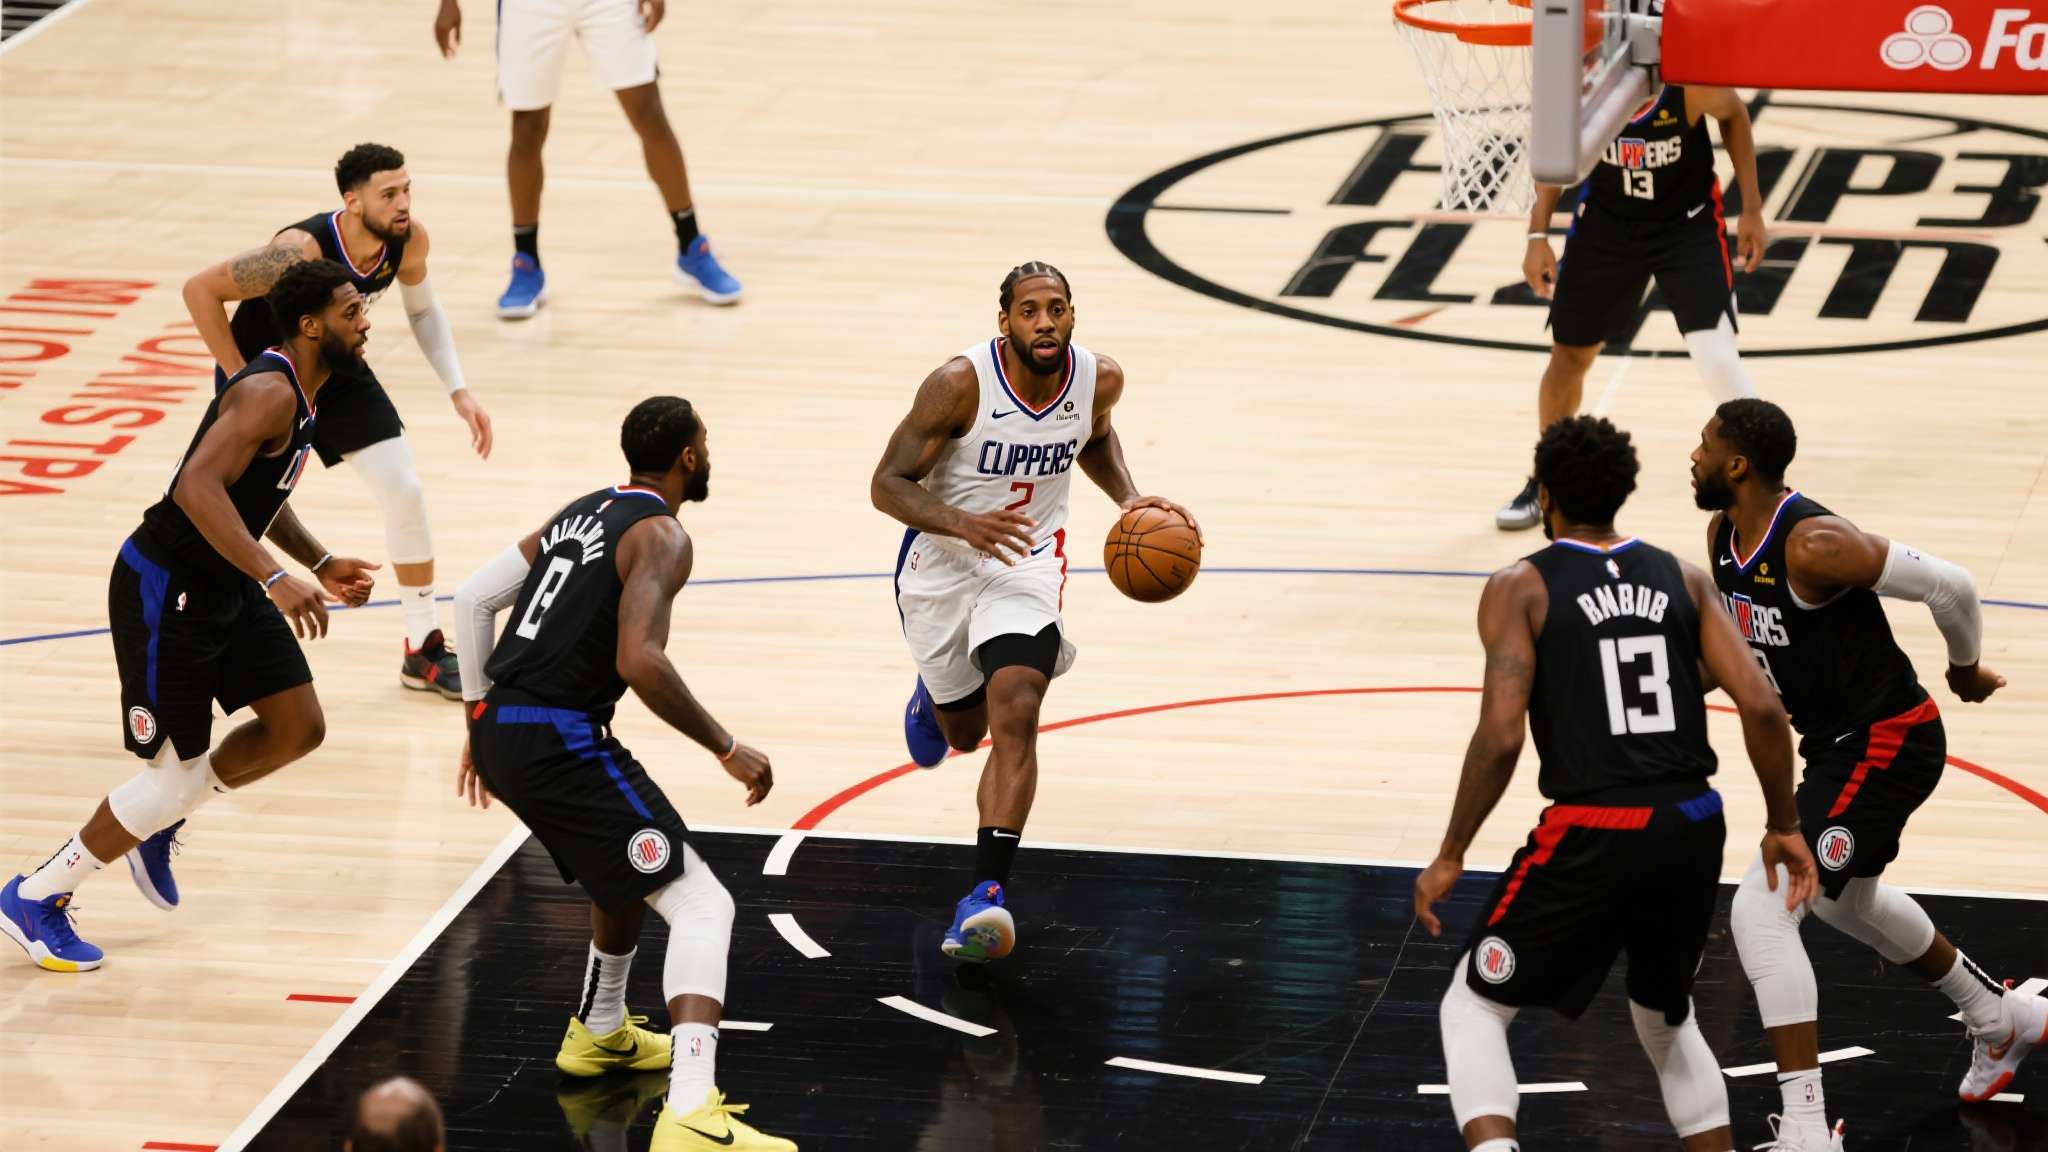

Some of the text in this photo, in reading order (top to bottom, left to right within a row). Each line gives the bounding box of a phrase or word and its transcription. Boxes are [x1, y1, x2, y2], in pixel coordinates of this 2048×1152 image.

[1622, 169, 1655, 201] 13
[977, 438, 1078, 477] CLIPPERS
[1598, 633, 1677, 737] 13
